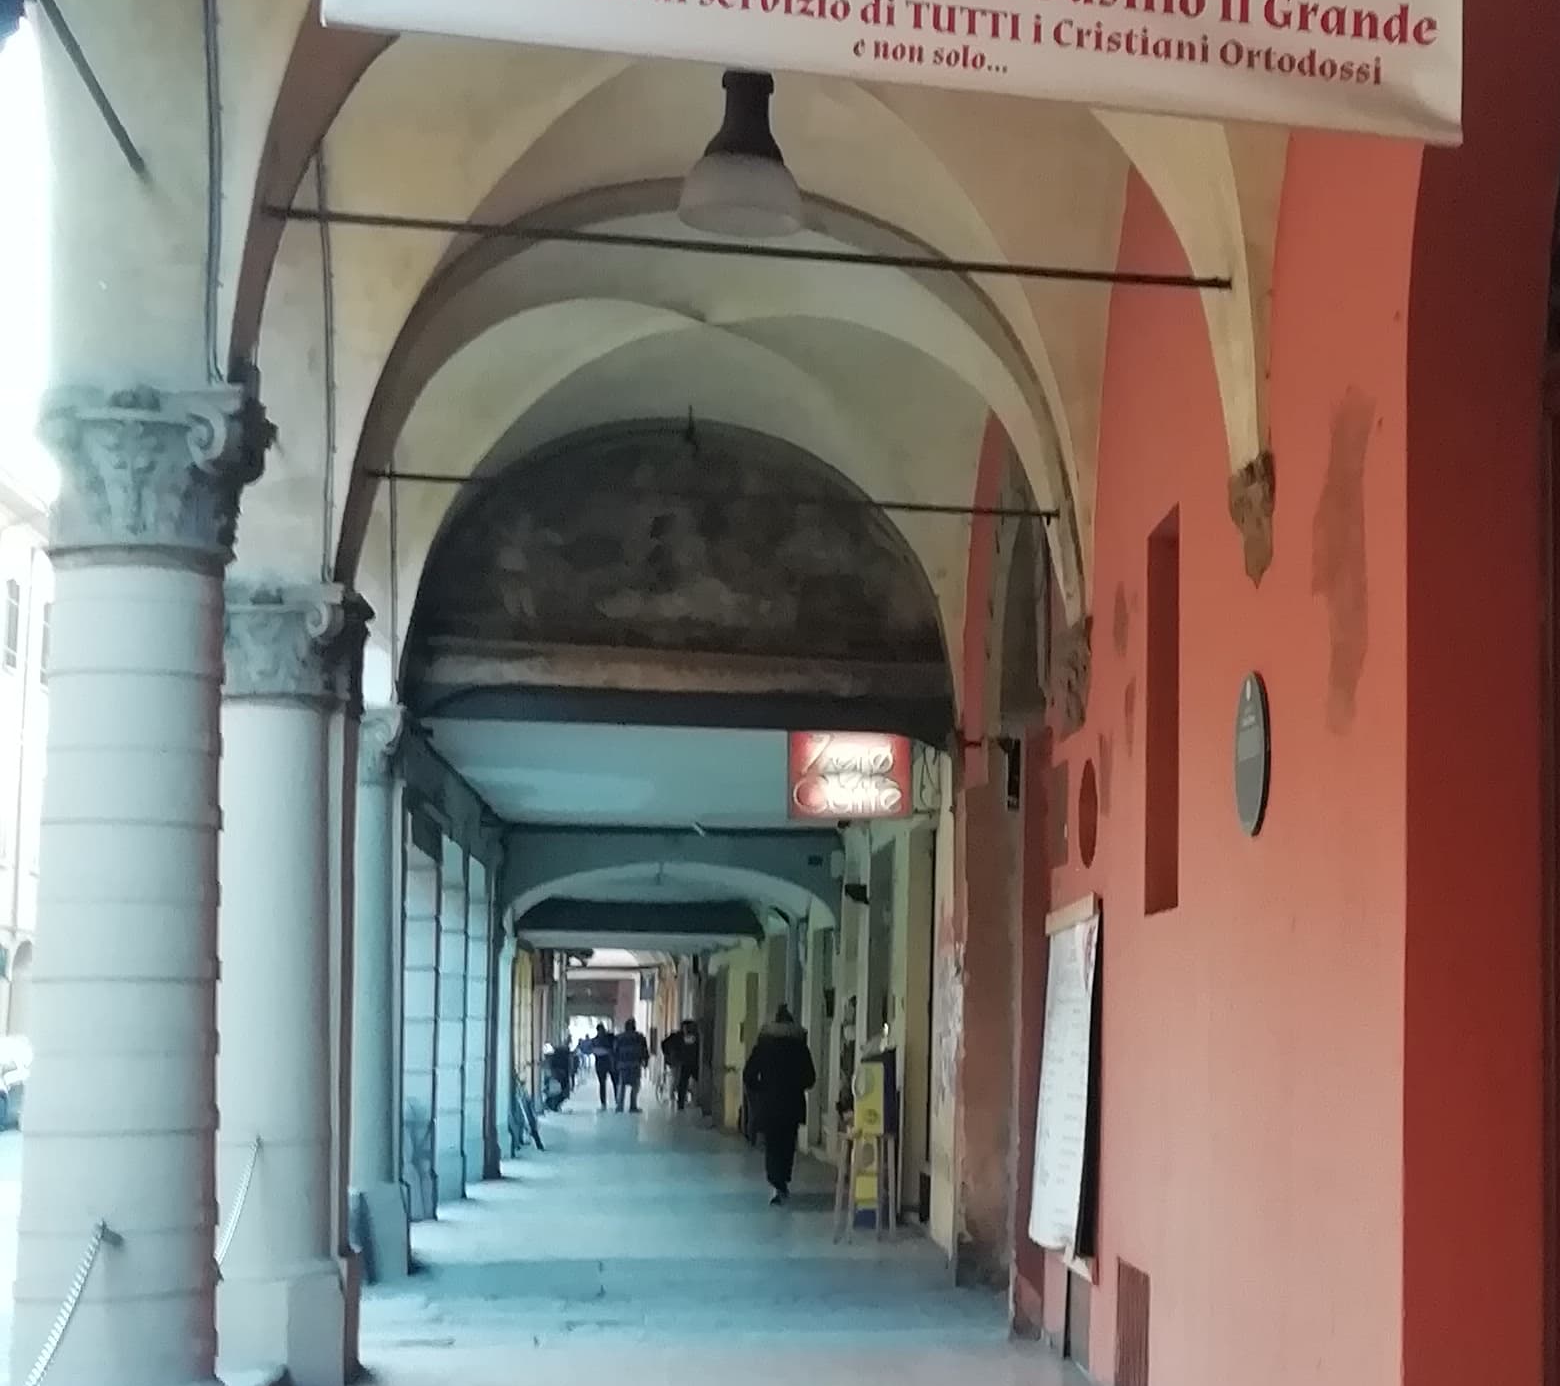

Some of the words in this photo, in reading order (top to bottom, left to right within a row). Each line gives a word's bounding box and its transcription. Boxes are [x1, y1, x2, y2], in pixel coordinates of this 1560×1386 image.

[853, 39, 865, 57] e
[874, 40, 924, 65] non
[933, 45, 1007, 73] solo...
[905, 0, 1020, 41] TUTTI
[1033, 14, 1041, 45] i
[1053, 19, 1208, 63] Cristiani
[1220, 39, 1381, 85] Ortodossi
